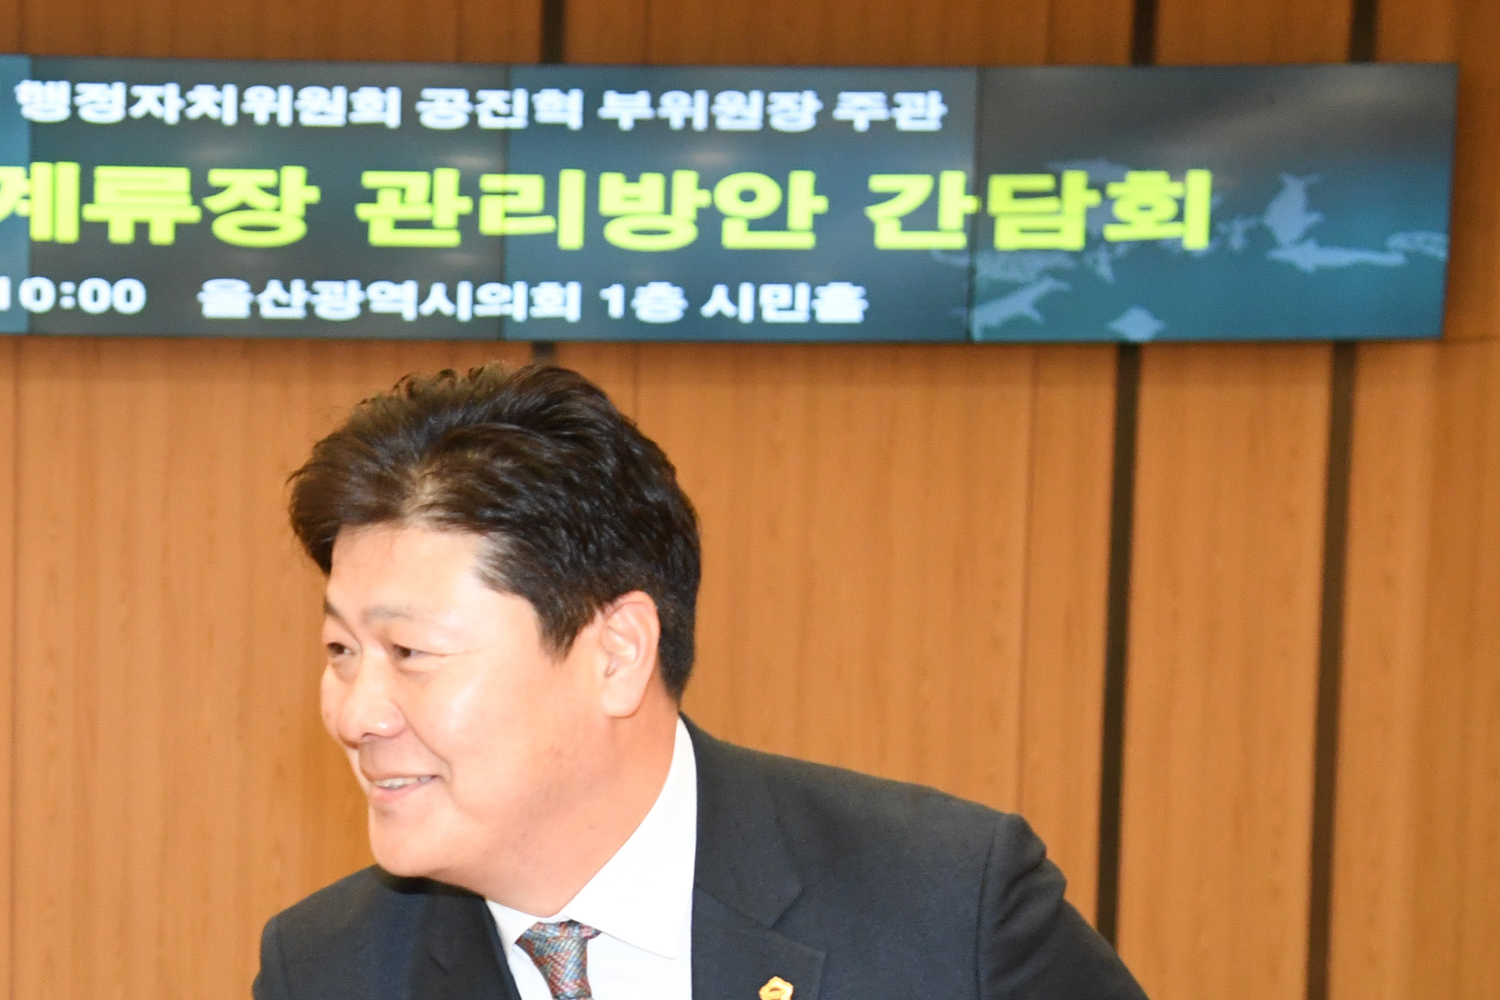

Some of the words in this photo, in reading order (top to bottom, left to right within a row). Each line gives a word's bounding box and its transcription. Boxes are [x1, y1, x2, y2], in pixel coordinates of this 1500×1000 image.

[15, 79, 402, 129] 행정자치위원회
[416, 87, 584, 130] 공진혁
[599, 90, 822, 132] 부위원장
[834, 91, 947, 132] 주관
[355, 167, 829, 252] 관리방안
[864, 169, 1212, 250] 간담회
[198, 278, 582, 323] 울산광역시의회
[600, 282, 688, 323] 1층
[700, 282, 867, 323] 시민홀
